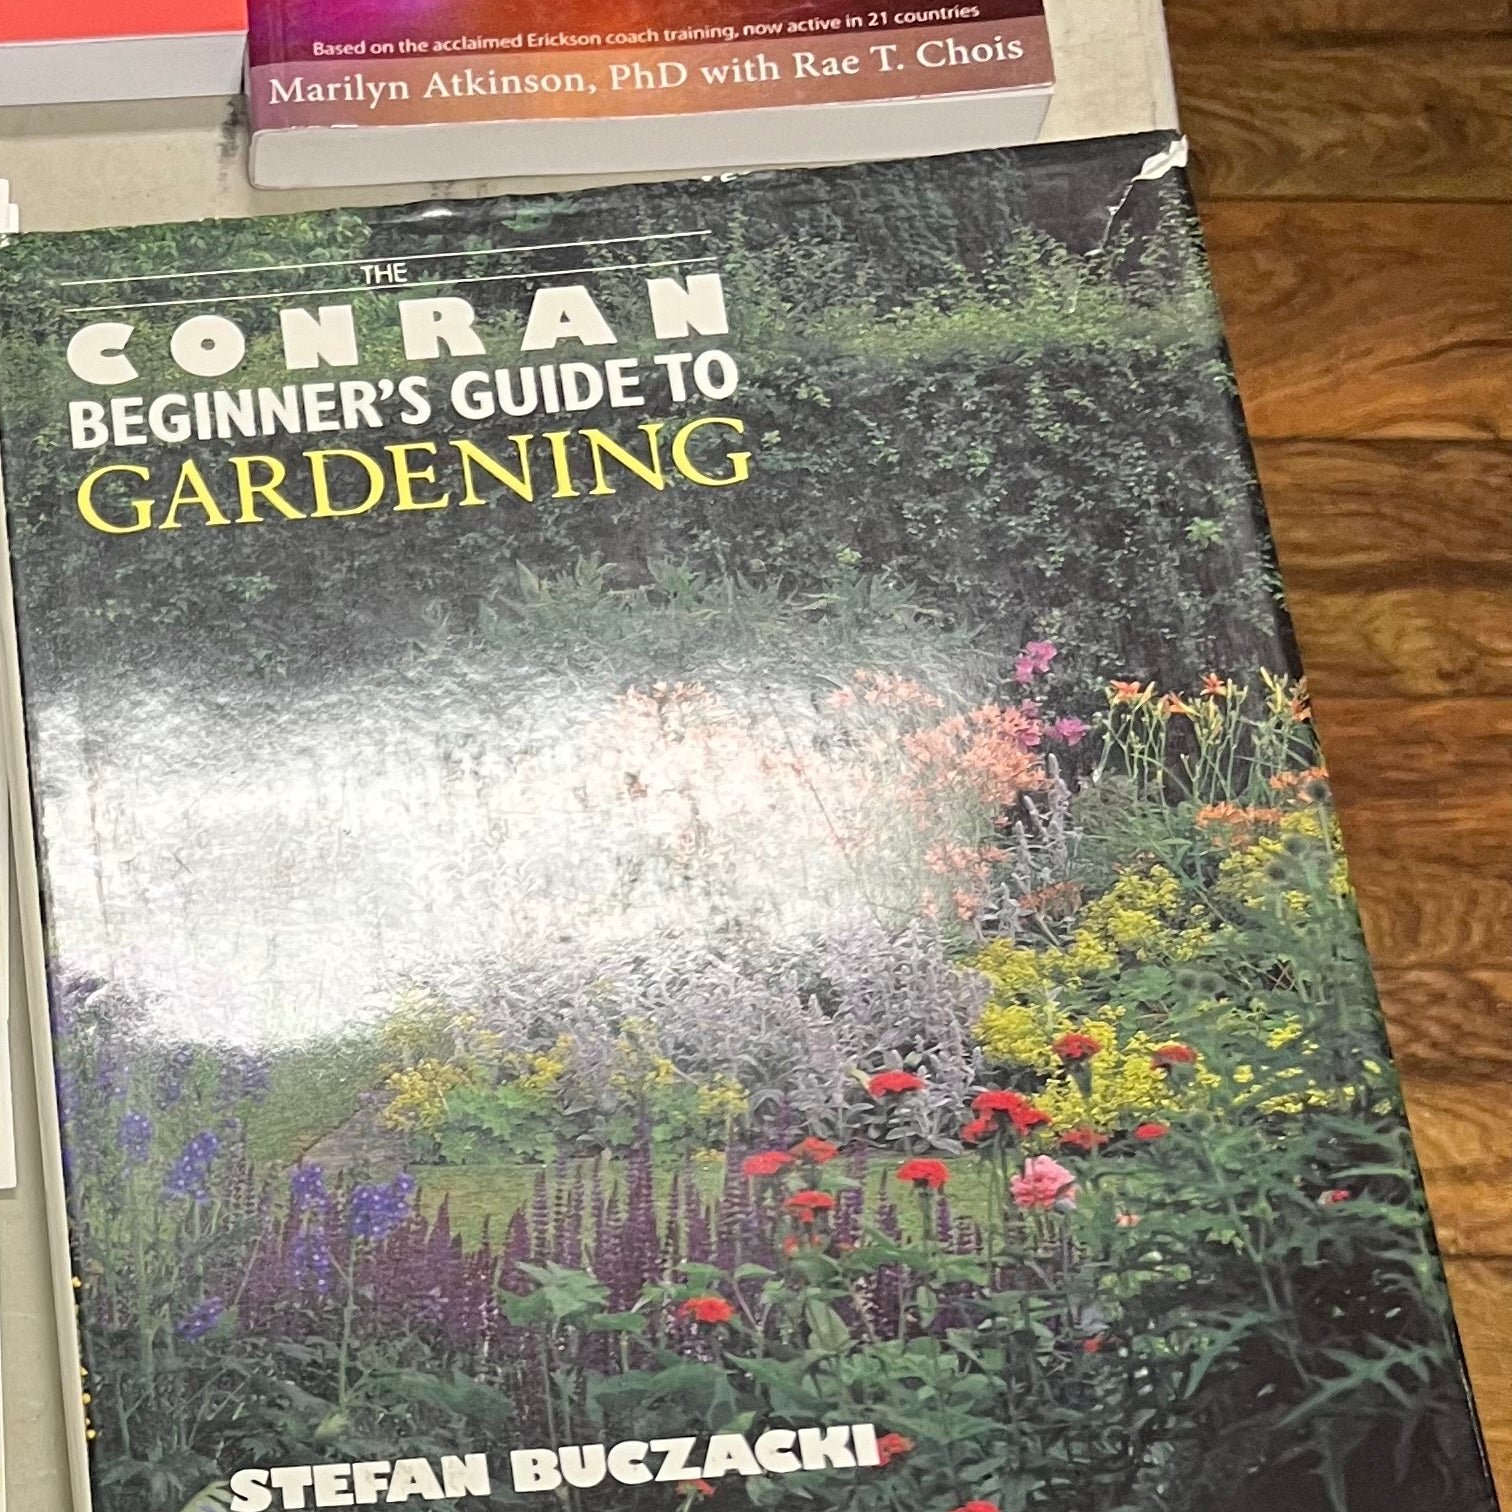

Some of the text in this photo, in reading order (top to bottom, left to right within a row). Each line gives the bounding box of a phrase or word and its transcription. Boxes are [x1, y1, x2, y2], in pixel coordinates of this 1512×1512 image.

[268, 35, 1024, 110] Marilyn Atkinson, PhD with Rae T. Chois
[313, 4, 980, 56] Based on the acclaimed Erickson coach training, now active in 21 countries
[360, 261, 408, 285] THE
[66, 273, 730, 385] CONRAN
[68, 349, 740, 449] BEGINNER'S GUIDE TO
[76, 416, 753, 535] GARDENING
[229, 1423, 881, 1512] STEFAN BUCZACKI
